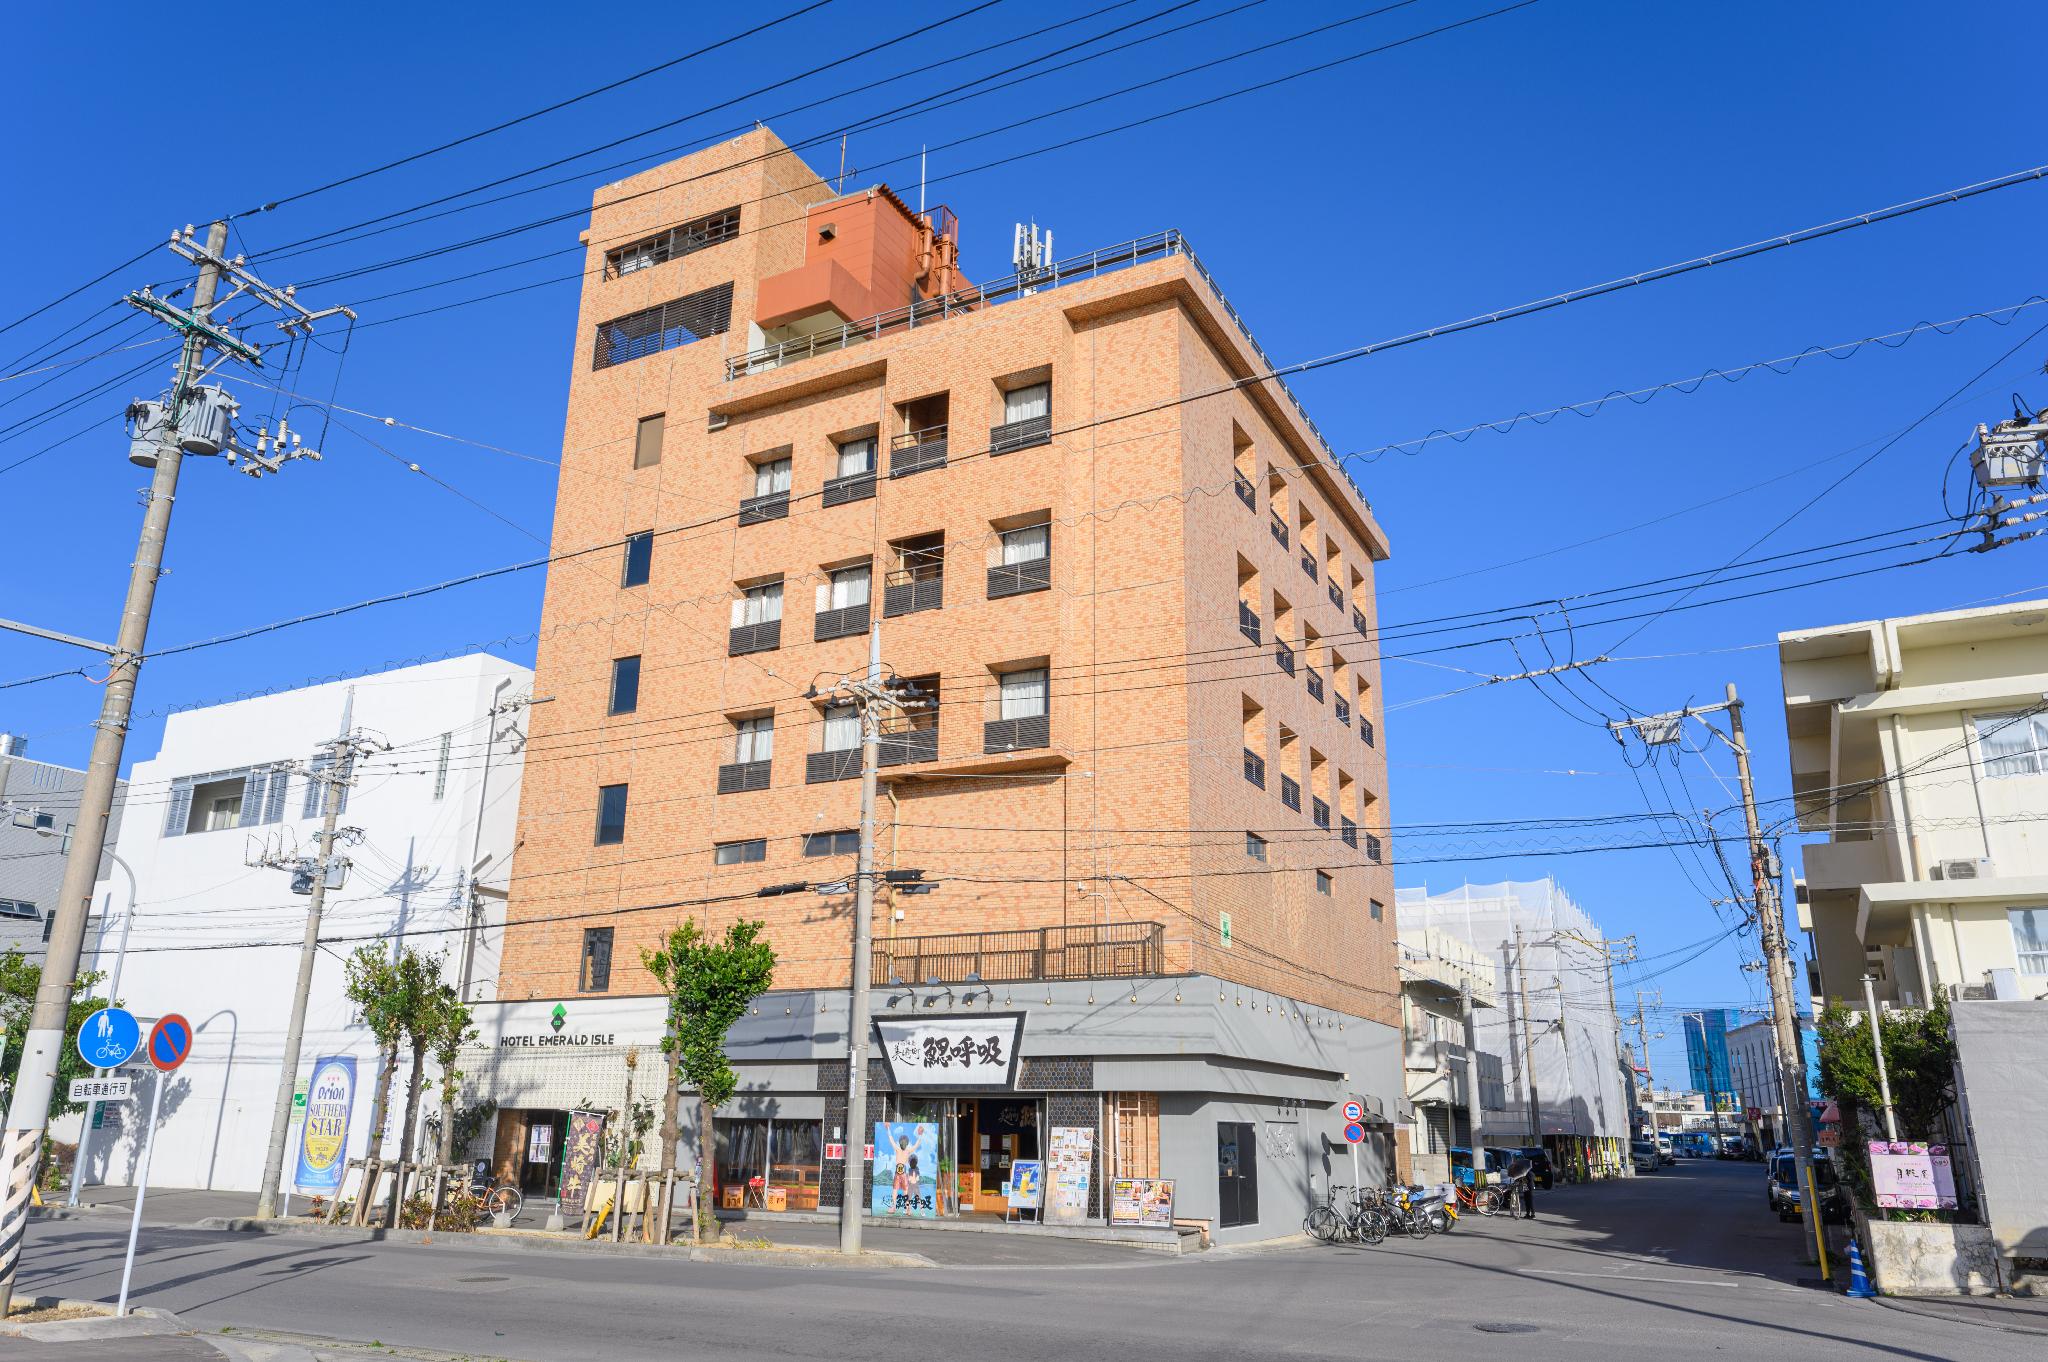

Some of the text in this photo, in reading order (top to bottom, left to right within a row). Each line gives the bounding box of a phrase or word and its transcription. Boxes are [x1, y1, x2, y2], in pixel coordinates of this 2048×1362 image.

[501, 1034, 615, 1047] HOTEL EMERALD ISLE
[74, 1082, 127, 1097] 自転車通行可
[318, 1082, 345, 1100] Orion
[310, 1103, 347, 1118] SOUTHERN
[310, 1117, 342, 1136] STAR
